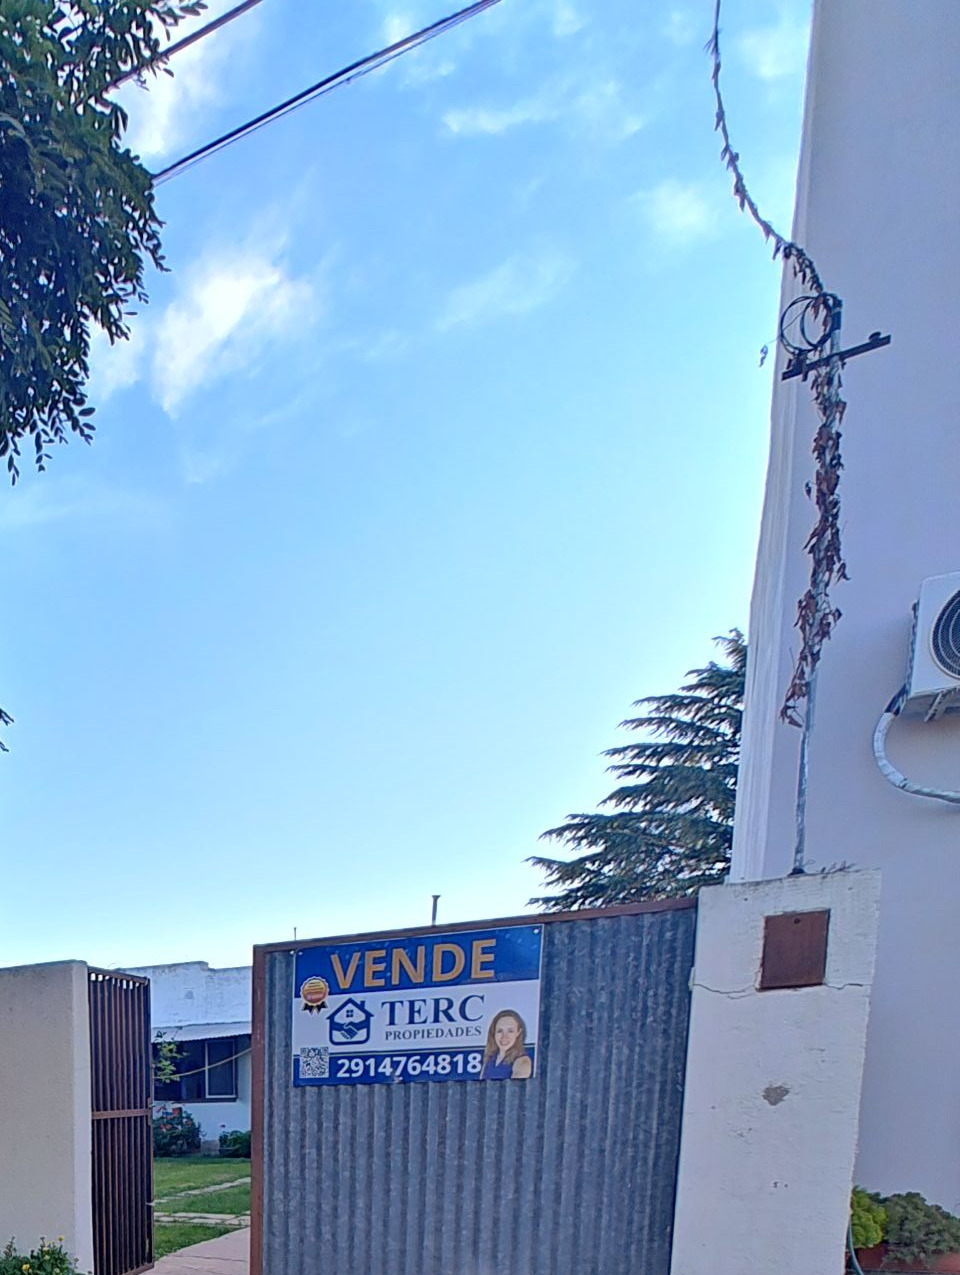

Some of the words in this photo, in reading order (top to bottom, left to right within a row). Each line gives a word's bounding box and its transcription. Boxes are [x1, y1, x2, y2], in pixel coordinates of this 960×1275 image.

[330, 938, 496, 990] VENDE
[381, 994, 485, 1026] TERC
[384, 1026, 482, 1041] PROPIEDADES
[336, 1052, 482, 1079] 2914764818
